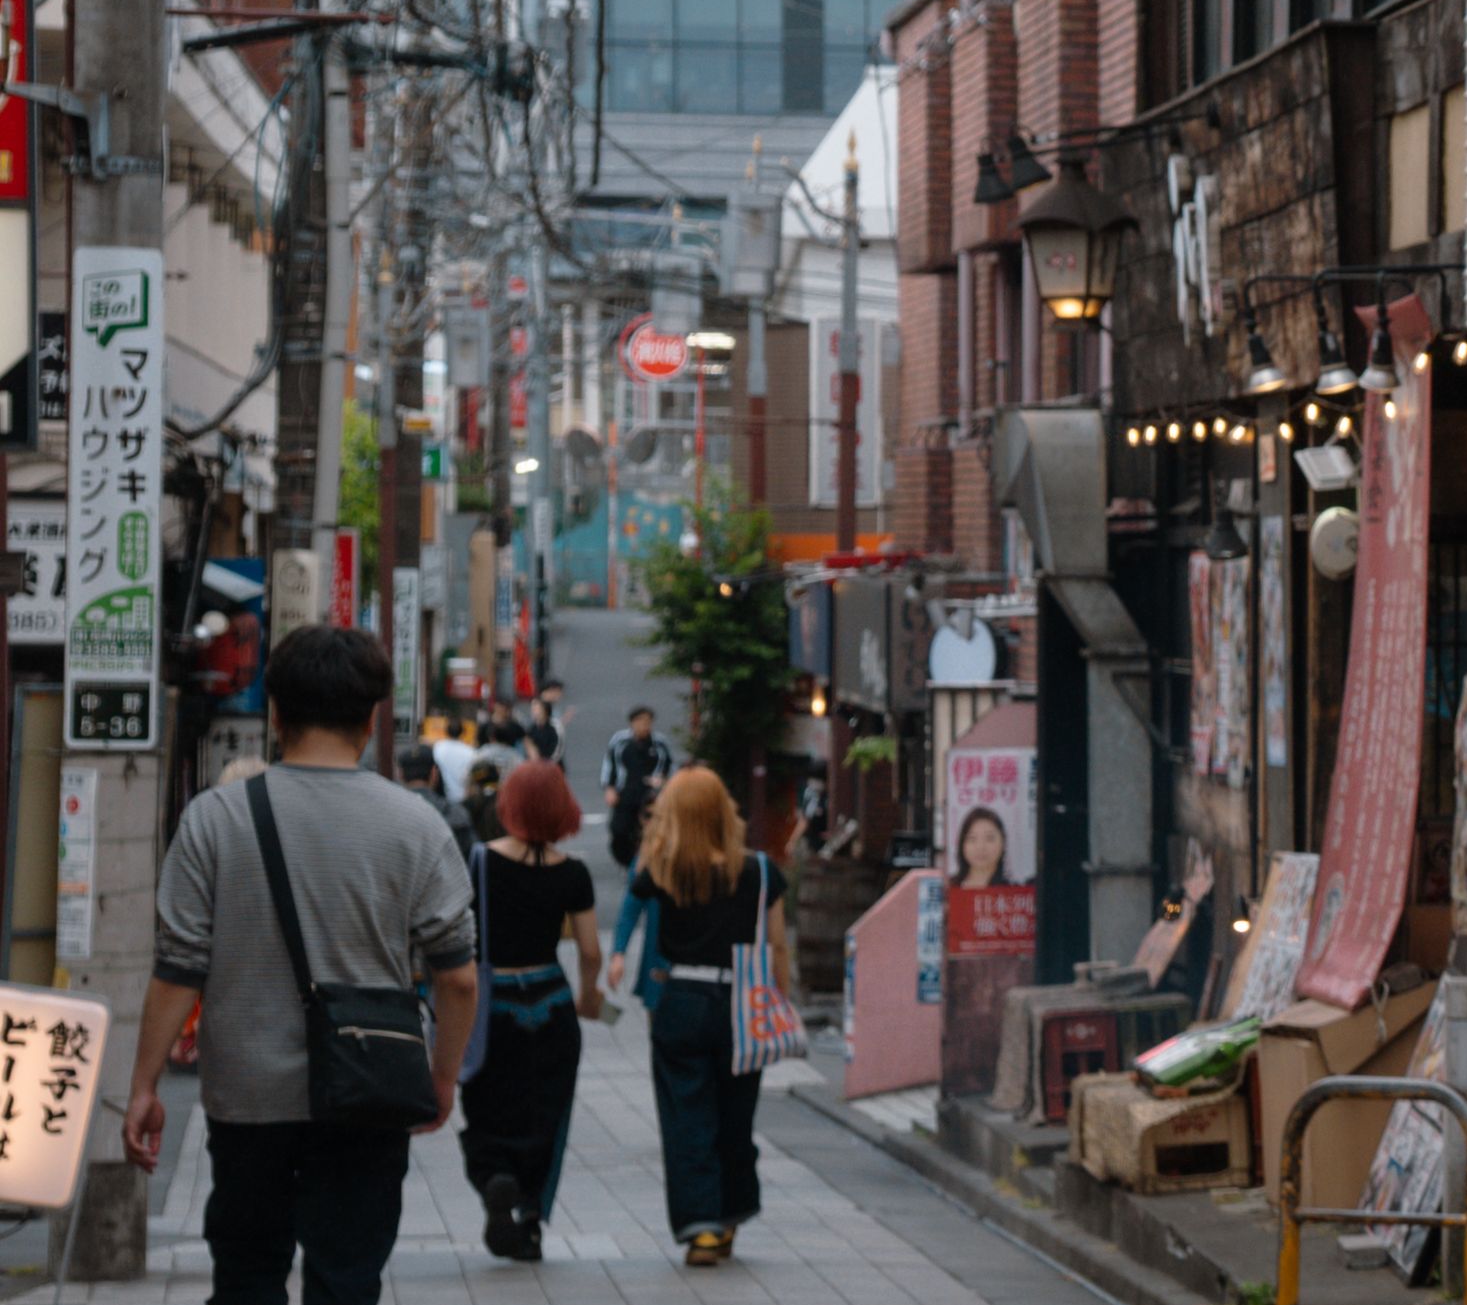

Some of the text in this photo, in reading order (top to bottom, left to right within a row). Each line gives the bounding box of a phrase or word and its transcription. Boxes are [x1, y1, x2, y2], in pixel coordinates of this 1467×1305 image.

[90, 280, 120, 296] この
[116, 349, 148, 503] マツザキ
[79, 385, 108, 585] ハウジング
[952, 756, 1019, 786] 伊藤
[41, 1019, 89, 1134] 餃子と
